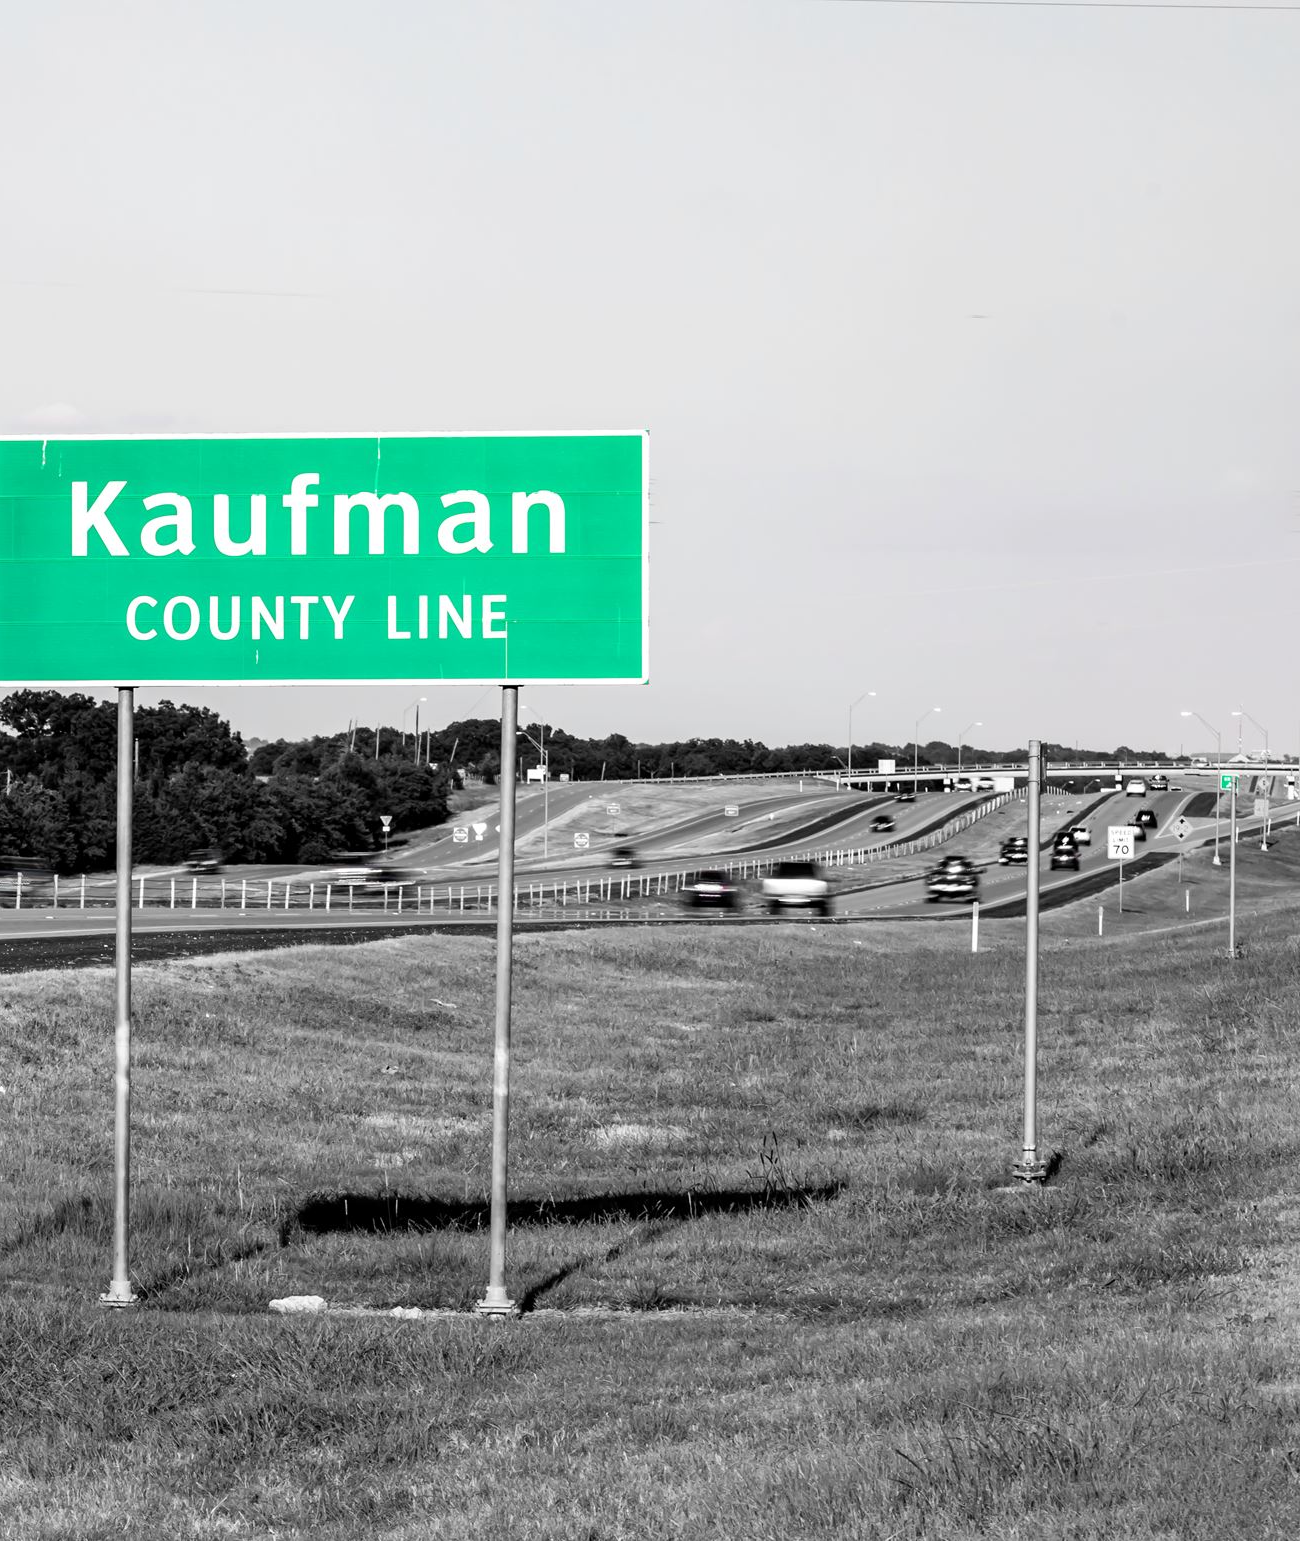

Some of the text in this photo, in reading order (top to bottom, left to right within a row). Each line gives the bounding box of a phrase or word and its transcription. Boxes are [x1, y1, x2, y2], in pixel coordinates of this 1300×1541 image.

[71, 472, 566, 557] Kaufman
[126, 594, 508, 641] COUNTY LINE
[1113, 844, 1130, 855] 70
